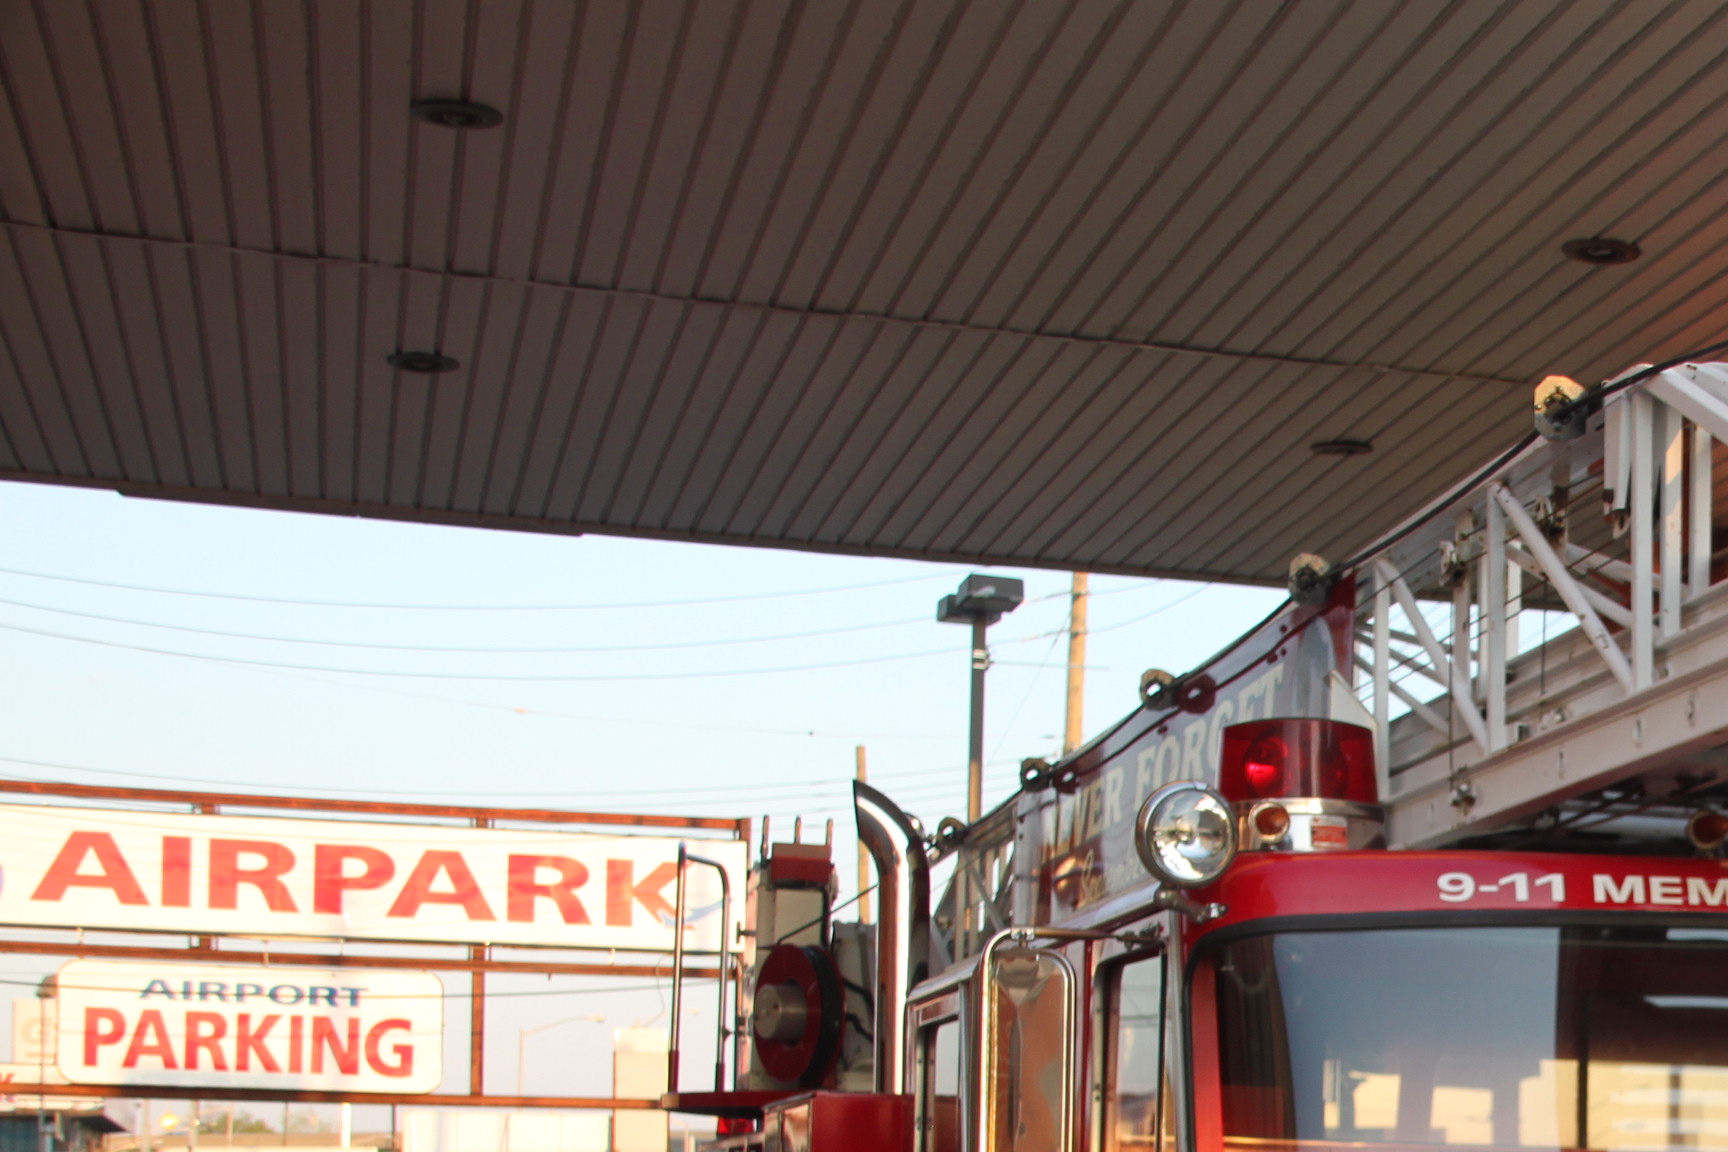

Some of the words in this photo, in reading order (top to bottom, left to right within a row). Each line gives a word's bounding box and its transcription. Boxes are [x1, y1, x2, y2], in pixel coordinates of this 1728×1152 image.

[30, 831, 697, 930] AIRPARK
[1437, 872, 1565, 902] 9-11
[139, 979, 369, 1008] AIRPORT
[83, 1006, 415, 1078] PARKING
